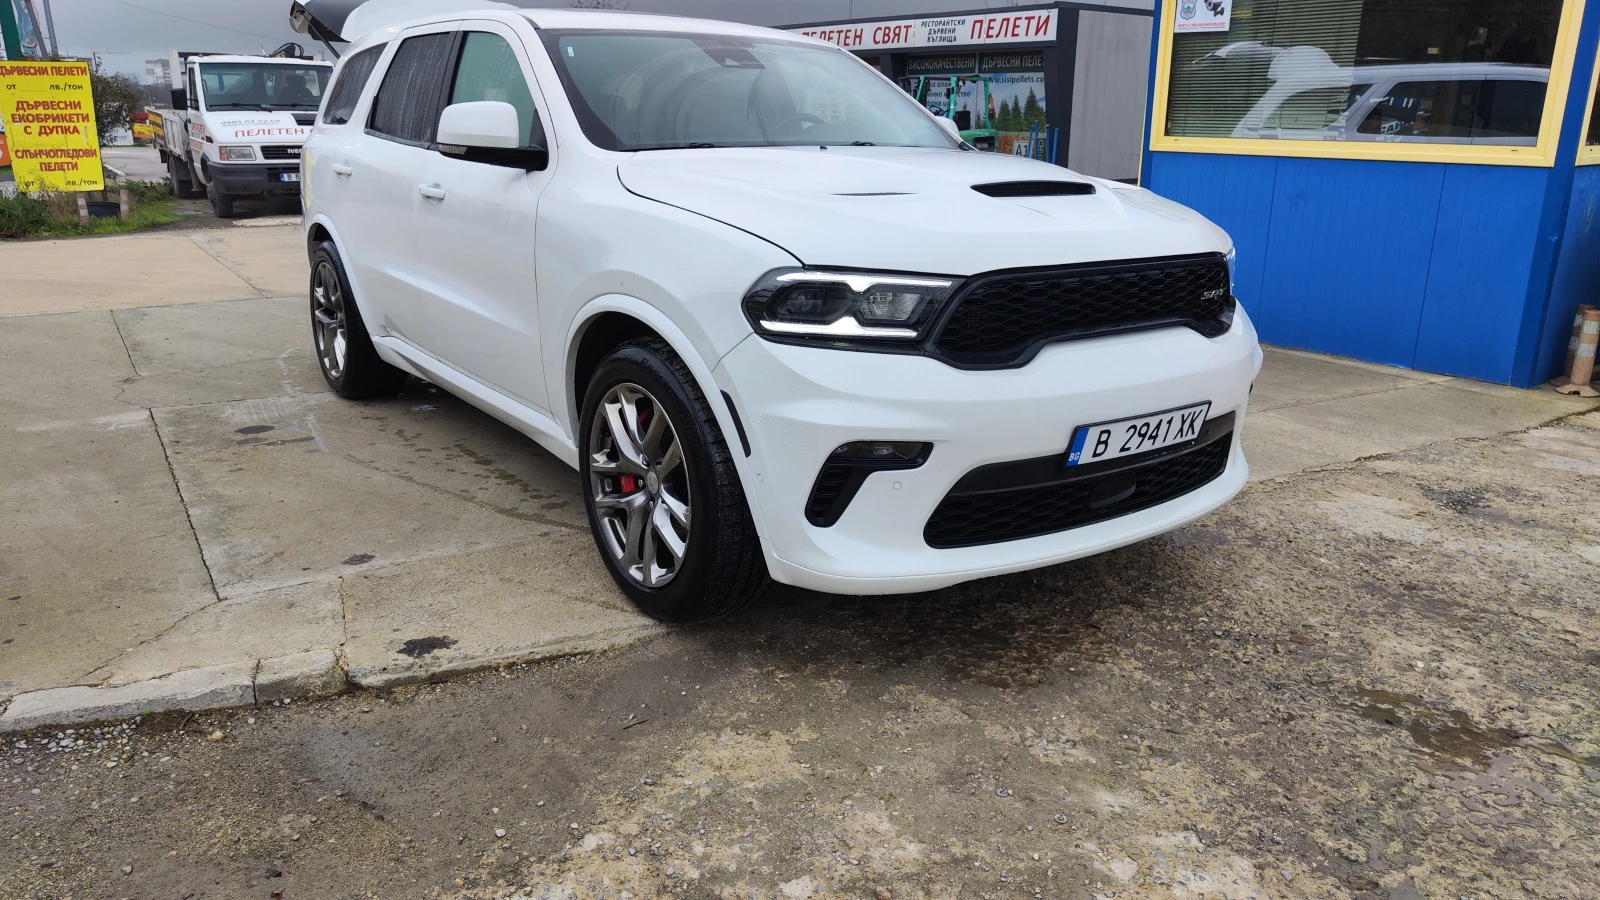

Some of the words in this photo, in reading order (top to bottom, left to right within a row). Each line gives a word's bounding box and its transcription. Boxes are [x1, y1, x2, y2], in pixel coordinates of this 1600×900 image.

[921, 18, 966, 28] РЕСТОРАНТСКИ
[970, 14, 1050, 40] ПЕЛЕТИ
[872, 24, 912, 45] СВЯТ
[928, 27, 956, 36] ДЪРВЕНИ
[926, 35, 957, 44] ВЪГЛИЩА
[908, 56, 975, 70] ВИСОКОКАЧЕСТВЕНИ
[982, 55, 1021, 71] ДЪРВЕСНИ
[0, 66, 49, 77] ДЪРВЕСНИ
[50, 66, 88, 76] ПЕЛЕТИ
[15, 100, 82, 112] ДЪРВЕСНИ
[11, 113, 90, 123] ЕКОБРИКЕТИ
[23, 125, 32, 135] С
[38, 125, 80, 137] ДУПКА
[234, 127, 304, 138] ПЕЛЕТЕН
[15, 148, 98, 160] СЛЪНЧОГЛЕДОВИ
[39, 161, 79, 172] ПЕЛЕТИ
[1092, 429, 1112, 458] B
[1119, 416, 1174, 453] 2941
[1173, 409, 1204, 440] XK
[1068, 452, 1081, 461] BG
